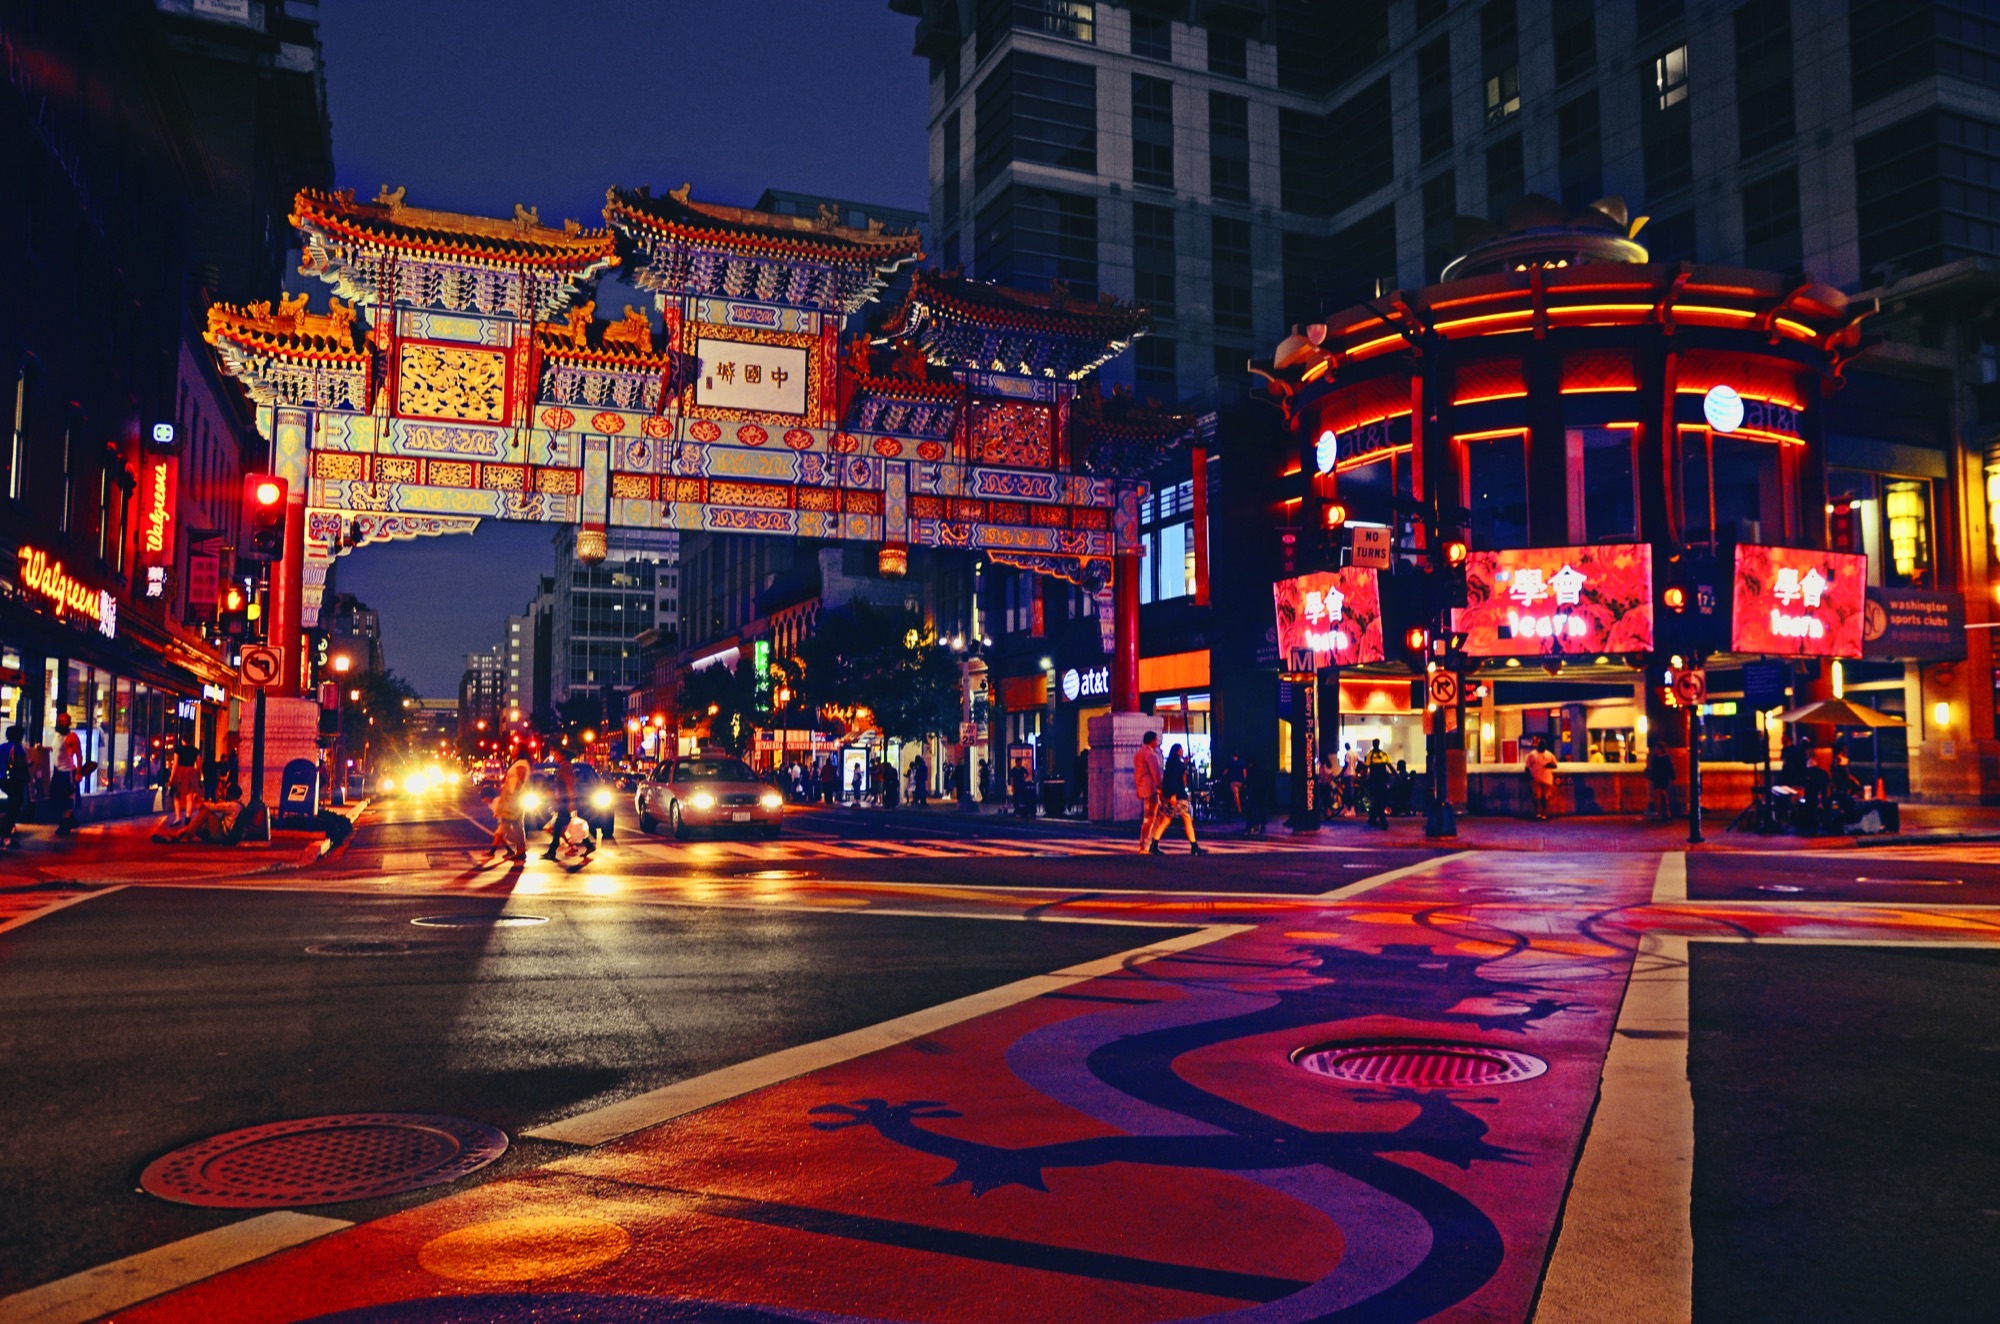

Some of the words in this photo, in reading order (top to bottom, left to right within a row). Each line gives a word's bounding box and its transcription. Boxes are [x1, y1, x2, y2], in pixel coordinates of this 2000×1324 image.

[1748, 401, 1800, 438] at&t
[1341, 420, 1394, 460] at&t
[146, 462, 171, 552] Walgreens
[1366, 531, 1379, 542] NO
[1357, 547, 1386, 559] TURNS
[19, 546, 99, 621] Walgreens
[1510, 565, 1587, 606] 學會
[1890, 600, 1948, 613] washington
[1890, 615, 1921, 626] sports
[1923, 616, 1949, 627] clubs
[1507, 611, 1587, 637] learn
[1292, 650, 1313, 672] M
[1080, 666, 1109, 696] at&t
[1306, 778, 1315, 811] Station
